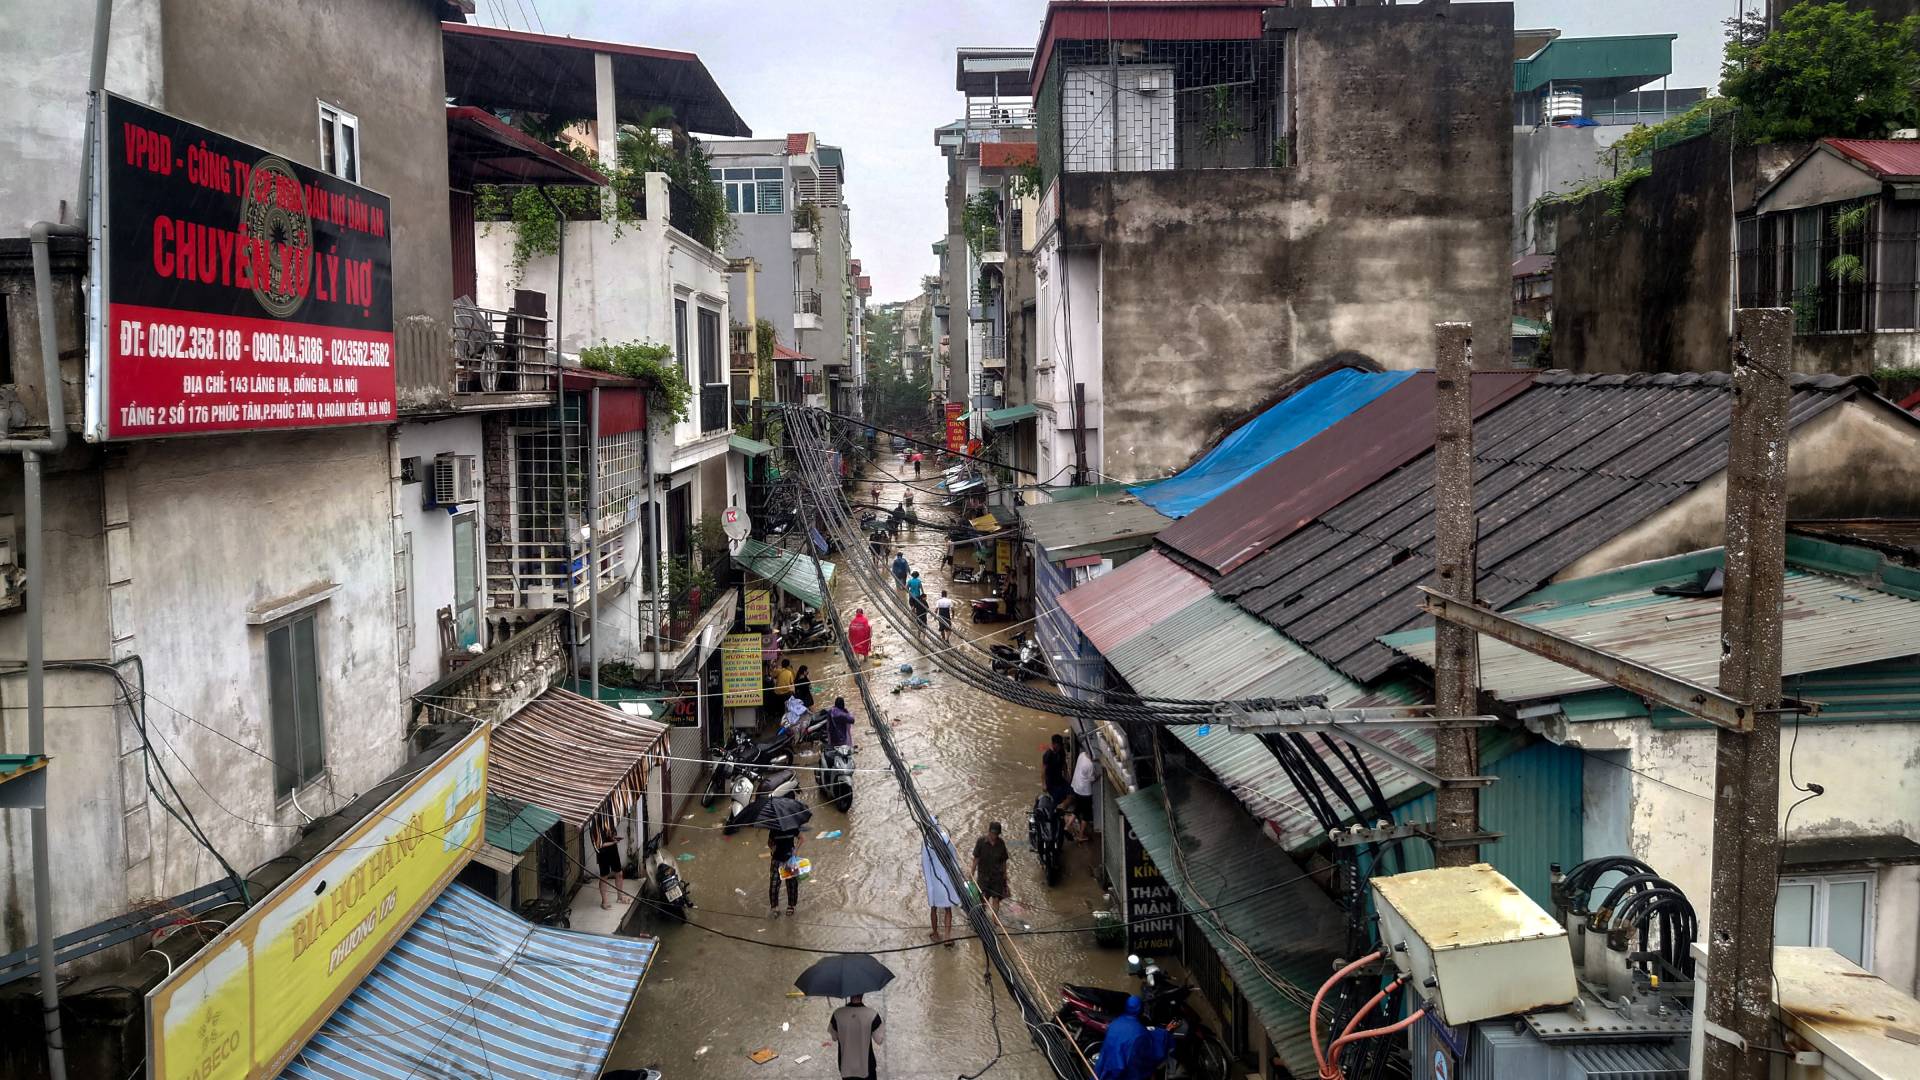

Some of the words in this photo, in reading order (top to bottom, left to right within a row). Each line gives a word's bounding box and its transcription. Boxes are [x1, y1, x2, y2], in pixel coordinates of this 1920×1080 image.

[187, 139, 231, 194] CÔNG
[233, 160, 250, 199] TY
[304, 180, 329, 221] BÁN
[330, 192, 346, 233] NỢ
[370, 206, 386, 238] AN
[153, 215, 270, 292] CHUYÊN
[279, 229, 313, 298] XỬ
[315, 244, 339, 303] LÝ
[345, 258, 374, 317] NỢ
[120, 320, 144, 357] ĐT:
[148, 323, 241, 361] 0902.358.188
[252, 331, 323, 364] 0906.84.5086
[331, 338, 390, 367] 0243562.5682
[183, 375, 203, 397] ĐỊA
[205, 370, 227, 393] CHỈ:
[230, 376, 248, 393] 143
[250, 373, 275, 393] LÁNG
[277, 377, 292, 396] HẠ,
[293, 372, 317, 393] ĐỐNG
[318, 378, 332, 394] ĐA,
[333, 376, 343, 393] HÀ
[345, 376, 358, 395] NỘI
[121, 400, 155, 426] TẦNG
[158, 406, 166, 425] 2
[169, 400, 185, 425] SỐ
[188, 405, 208, 424] 176
[211, 401, 240, 423] PHÚC
[296, 400, 316, 420] TÂN,
[368, 398, 379, 415] HÀ
[379, 398, 391, 417] NỘI
[1134, 862, 1162, 878] KÍN
[379, 888, 398, 923] 176
[1131, 886, 1171, 899] THAY
[1134, 900, 1171, 915] MÀN
[292, 899, 328, 962] BIA
